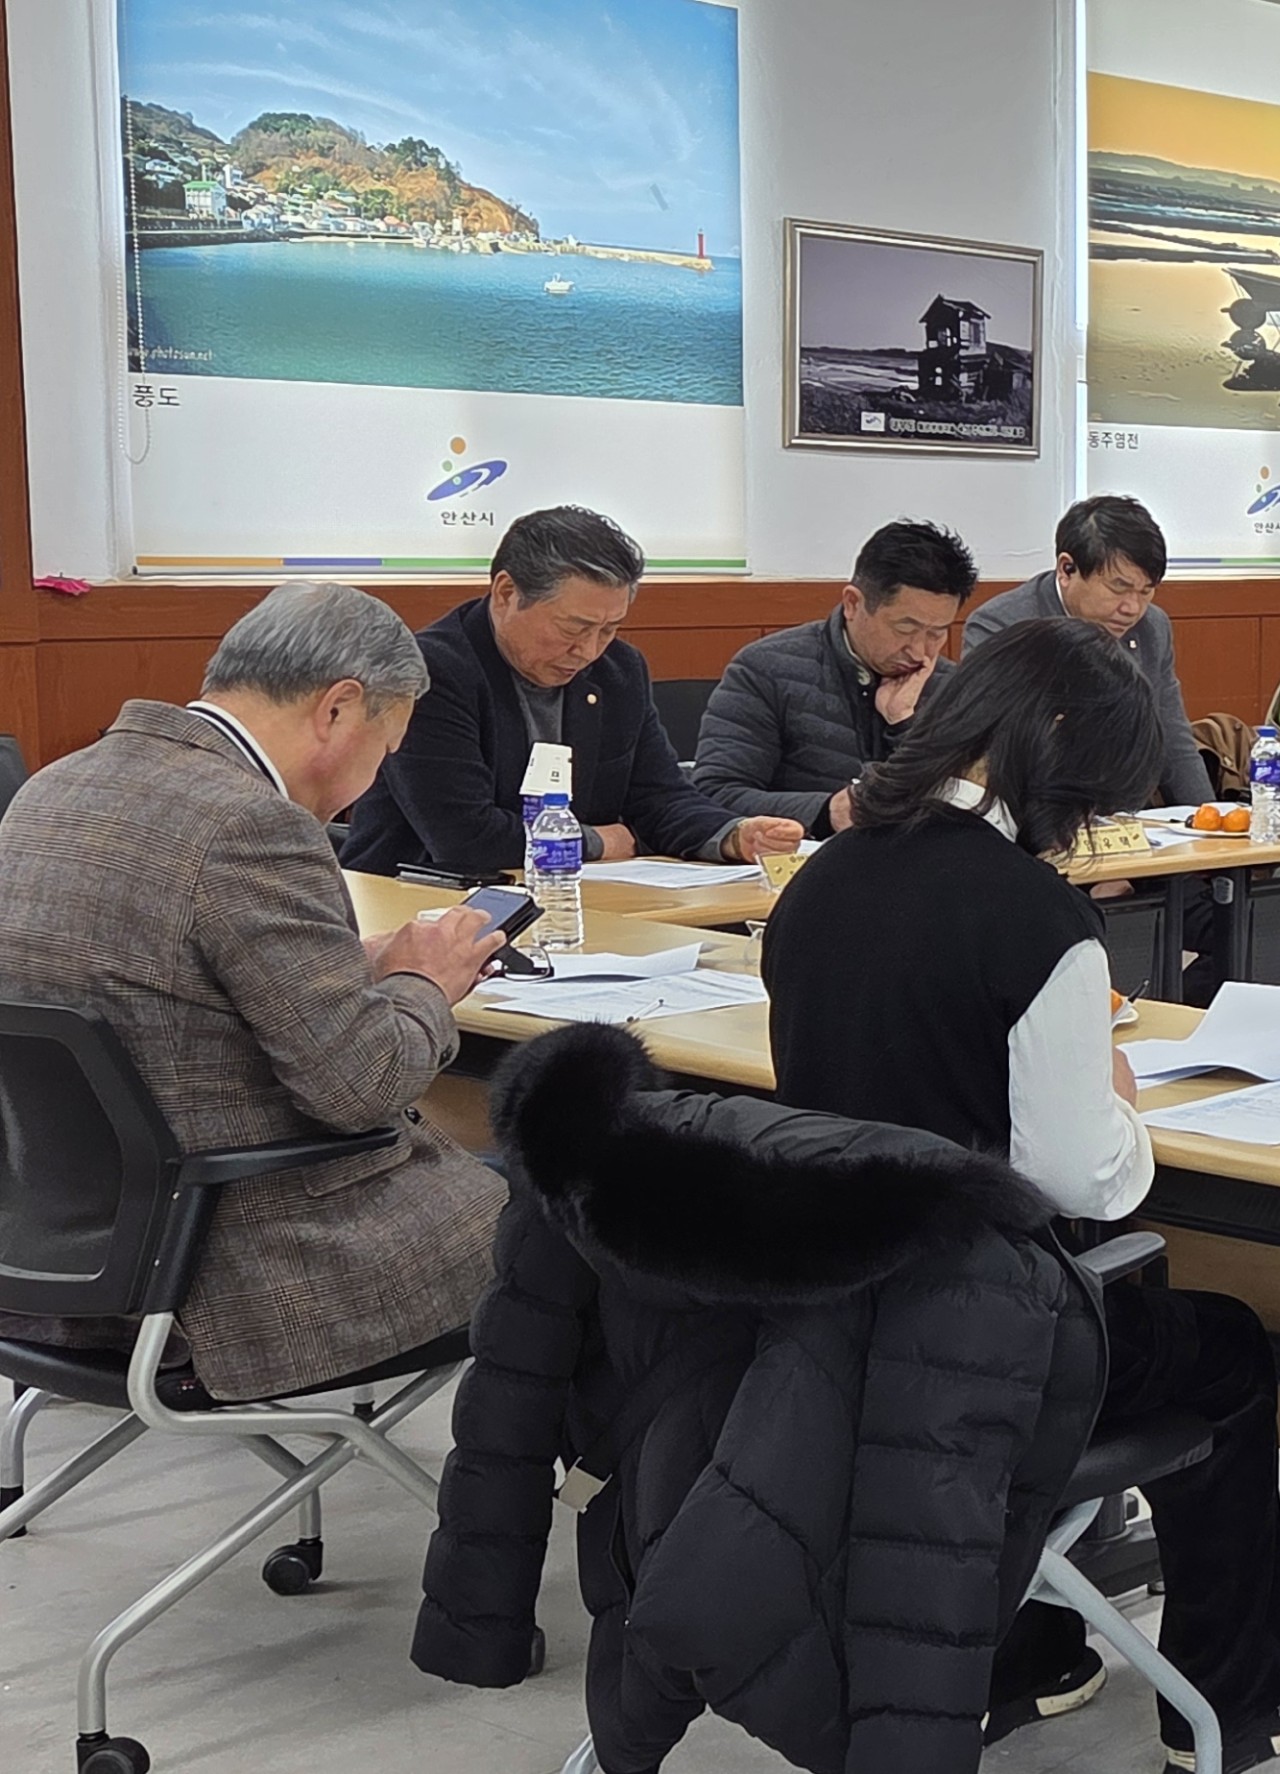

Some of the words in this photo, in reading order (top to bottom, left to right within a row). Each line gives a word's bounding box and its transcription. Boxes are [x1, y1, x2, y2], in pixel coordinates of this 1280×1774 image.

[132, 383, 181, 408] 풍도
[1087, 431, 1139, 450] 동주염전
[440, 511, 494, 526] 안산시
